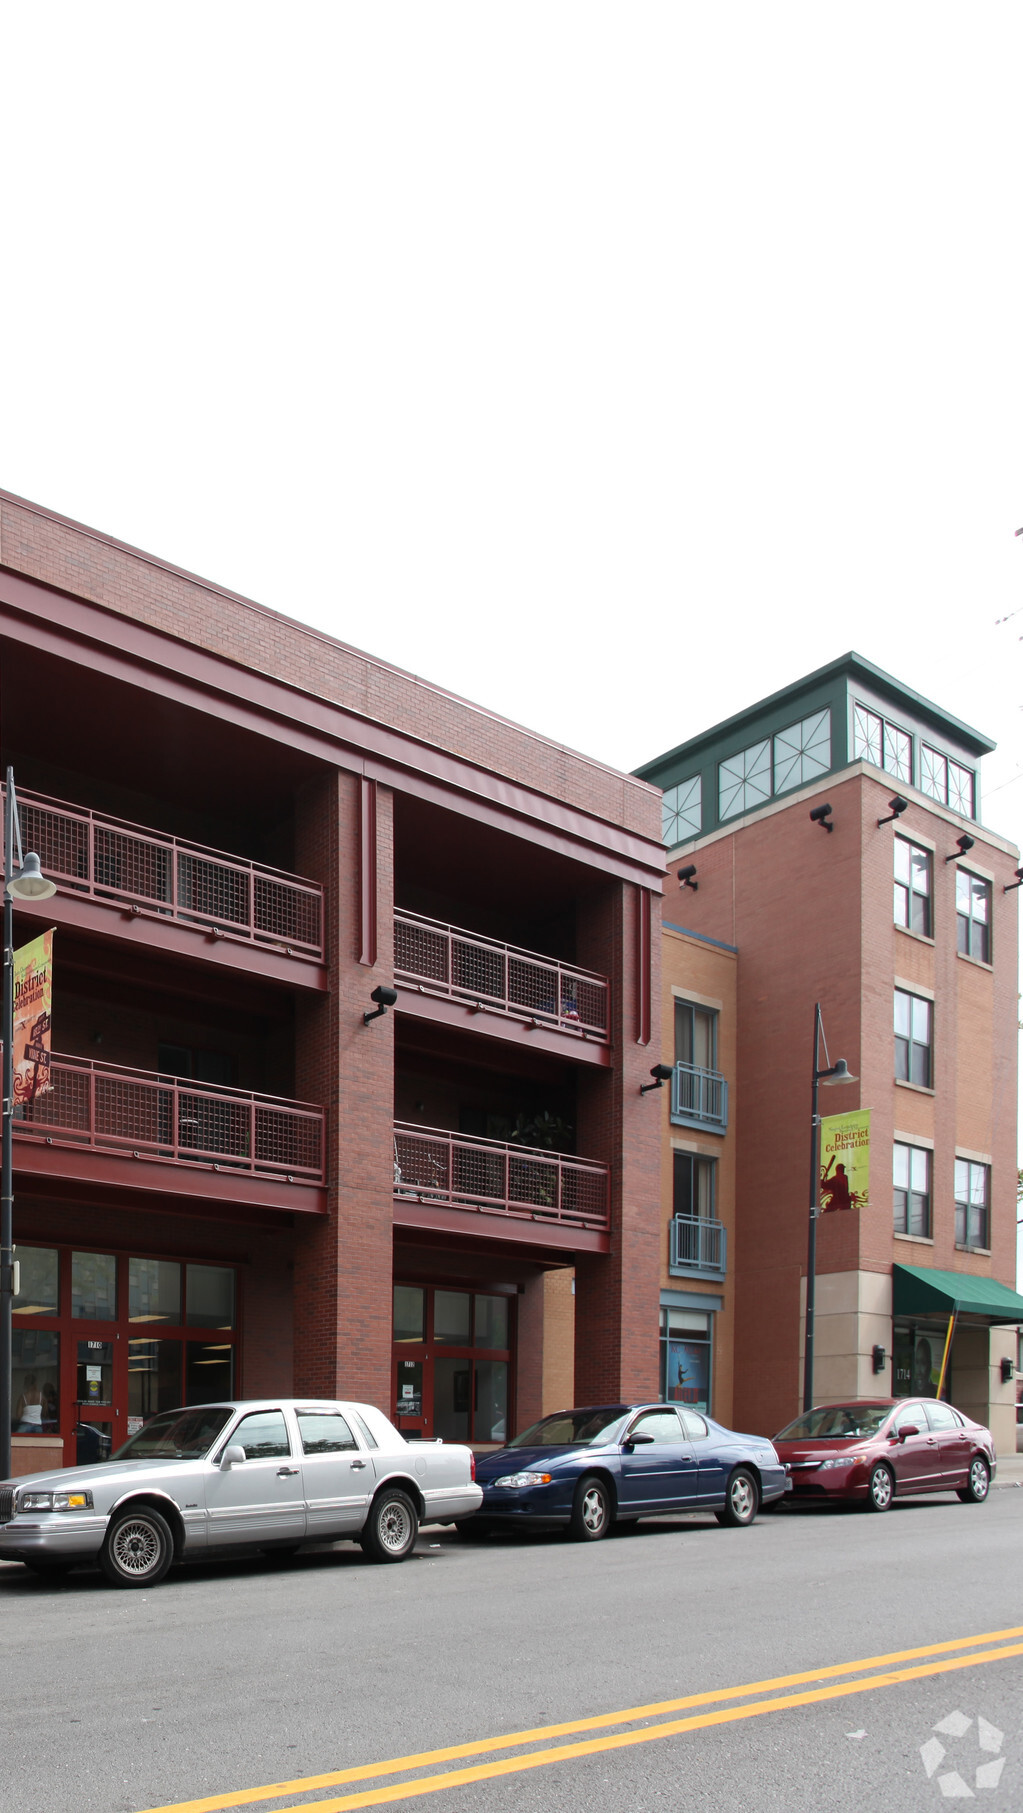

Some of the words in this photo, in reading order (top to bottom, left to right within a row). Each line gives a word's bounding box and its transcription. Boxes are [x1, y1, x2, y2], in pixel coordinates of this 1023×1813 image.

[15, 966, 47, 1000] District
[835, 1128, 868, 1142] District
[897, 1368, 911, 1380] 1714
